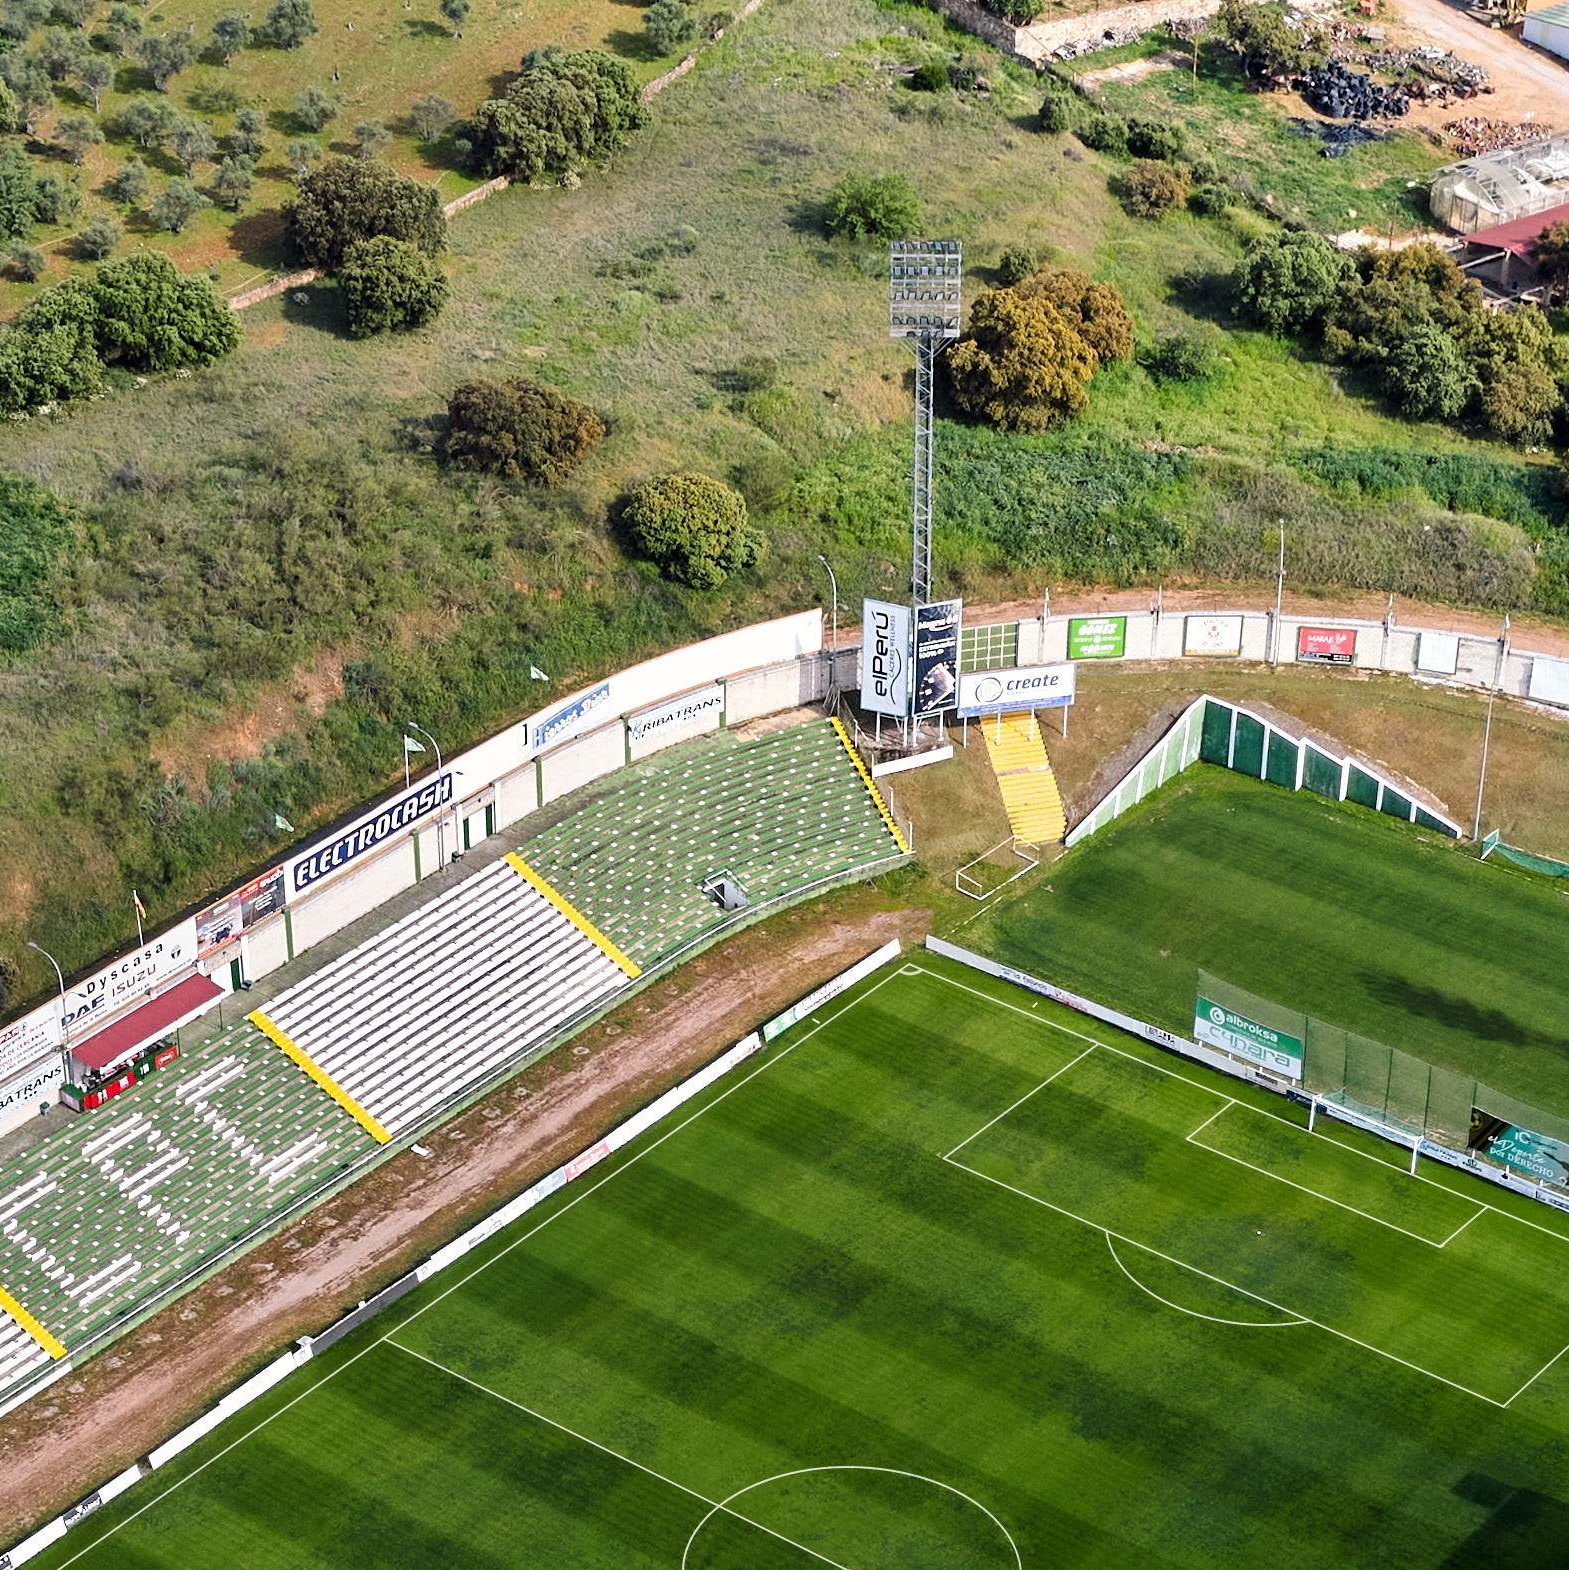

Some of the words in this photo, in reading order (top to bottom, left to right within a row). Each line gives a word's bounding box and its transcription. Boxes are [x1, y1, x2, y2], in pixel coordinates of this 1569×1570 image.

[1006, 674, 1059, 692] create
[642, 697, 721, 732] RIBATRANS
[297, 776, 451, 886] ELECTROCASH
[87, 943, 163, 995] Dyscasa
[61, 994, 105, 1028] DAF
[112, 964, 156, 997] ISUZU
[1226, 1014, 1278, 1043] albroksa
[1507, 1152, 1554, 1178] DERECHO
